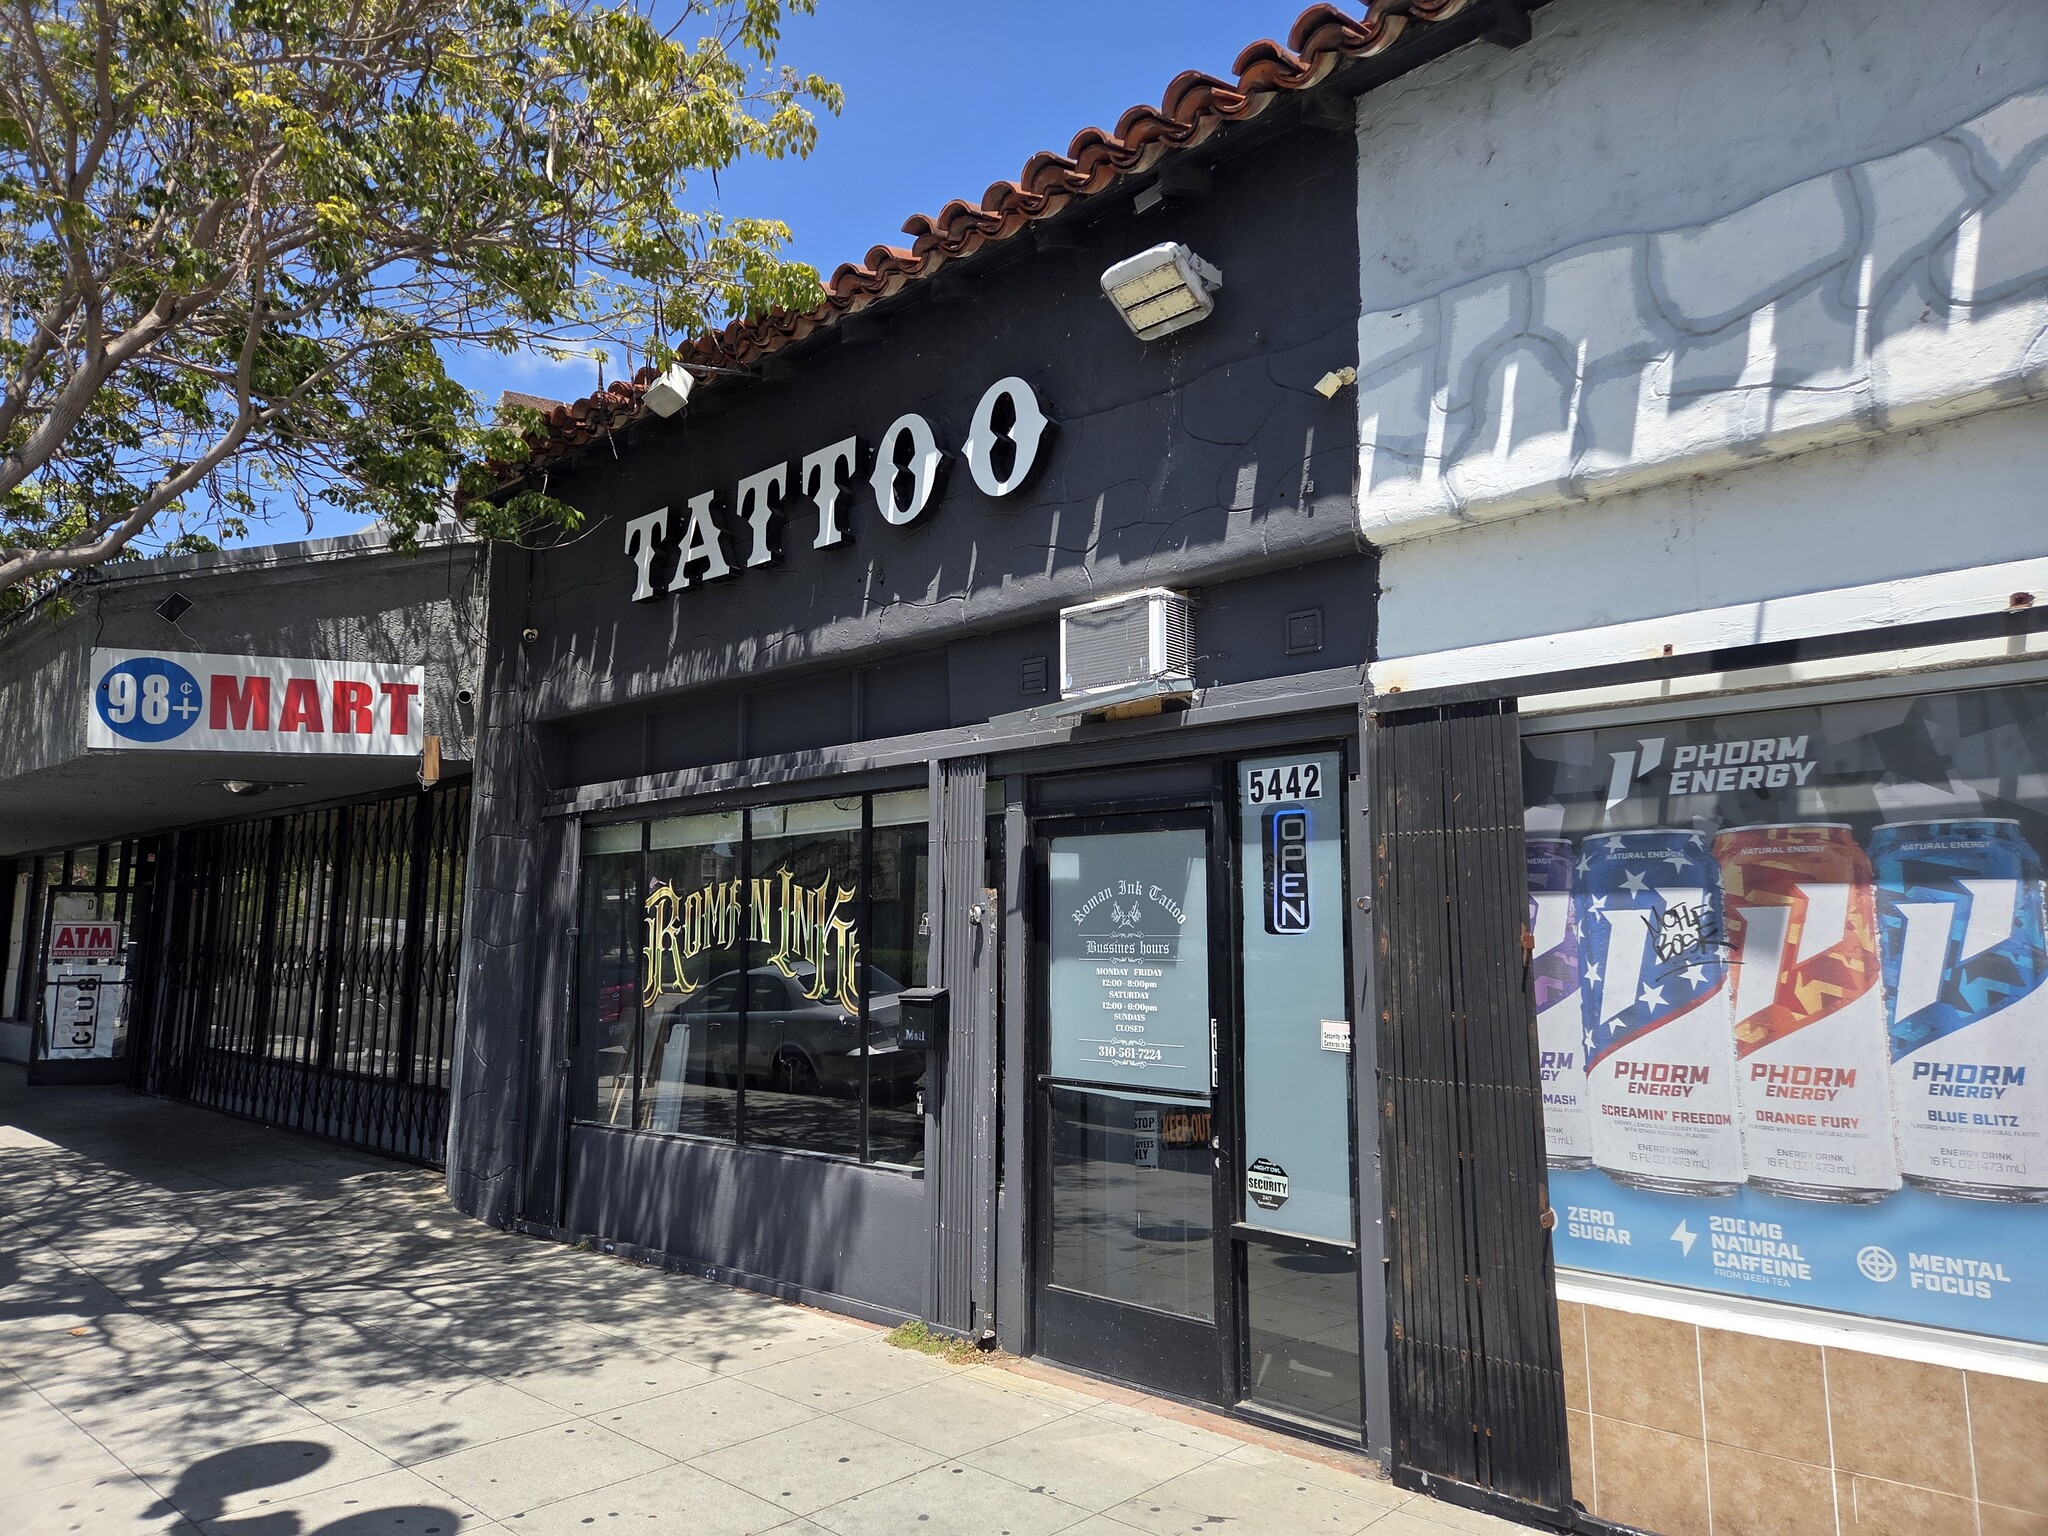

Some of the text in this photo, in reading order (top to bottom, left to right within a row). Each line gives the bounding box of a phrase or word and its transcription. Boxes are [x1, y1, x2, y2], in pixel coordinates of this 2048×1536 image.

[624, 376, 1048, 601] TATTOO
[209, 674, 418, 735] MART
[1673, 735, 1809, 769] PHORM
[1250, 765, 1320, 803] 5442
[1668, 761, 1818, 795] ENERGY
[1740, 845, 1824, 855] NATURAL ENERGY
[1900, 840, 1991, 851] NATURAL ENERGY
[1526, 857, 1551, 865] NERGY
[1605, 850, 1682, 861] NATURAL ENERGY
[1281, 818, 1305, 926] OPEN
[1071, 880, 1187, 926] Roman Ink Tattoo
[55, 927, 112, 948] ATM
[767, 861, 860, 1017] INK
[1086, 940, 1170, 955] Bussines hours
[1096, 968, 1163, 977] MONDAY FRIDAY
[1102, 979, 1122, 987] 12:00
[1127, 980, 1157, 990] 8:00pm
[1108, 991, 1150, 999] SATURDAY
[72, 978, 97, 1045] CLUB
[1102, 1002, 1122, 1010] 12:00
[1127, 1003, 1158, 1013] 6:00pm
[1113, 1013, 1146, 1021] SUNDAYS
[1115, 1024, 1145, 1033] CLOSED
[1098, 1046, 1162, 1060] 310-561-7224
[1614, 1060, 1710, 1085] PHORM
[1750, 1063, 1857, 1088] PHORM
[1912, 1061, 2026, 1086] PHORM
[1627, 1082, 1694, 1098] ENERGY
[1765, 1084, 1840, 1101] ENERGY
[1928, 1083, 2007, 1100] ENERGY
[1543, 1094, 1577, 1105] MASH
[1601, 1104, 1732, 1125] SCREAMIN' FREEDOM
[1756, 1110, 1859, 1129] ORANGE FURY
[1928, 1109, 2019, 1127] BLUE BLITZ
[1162, 1113, 1211, 1143] KEEP OUT
[1776, 1126, 1792, 1134] WITH
[1815, 1130, 1844, 1138] NATURAL
[1628, 1152, 1638, 1161] 16
[1640, 1153, 1651, 1163] FL
[1652, 1155, 1666, 1164] OZ
[1637, 1144, 1699, 1156] ENERGY DRINK
[1777, 1149, 1844, 1162] ENERGY DRINK
[1940, 1148, 2013, 1161] ENERGY DRINK
[1766, 1156, 1777, 1167] 16
[1778, 1158, 1792, 1169] FL
[1793, 1160, 1808, 1171] OZ
[1929, 1156, 1940, 1166] 16
[1942, 1158, 1956, 1168] FL
[1958, 1159, 1975, 1170] OZ
[1249, 1177, 1287, 1194] SECURITY
[1567, 1206, 1615, 1226] ZERO
[1568, 1222, 1632, 1246] SUGAR
[1749, 1221, 1782, 1240] MG
[1711, 1233, 1805, 1261] NATURAL
[1713, 1251, 1812, 1280] CAFFEINE
[1908, 1252, 2011, 1282] MENTAL
[1714, 1268, 1741, 1279] FROM
[1771, 1277, 1791, 1287] TEA
[1910, 1271, 1992, 1299] FOCUS
